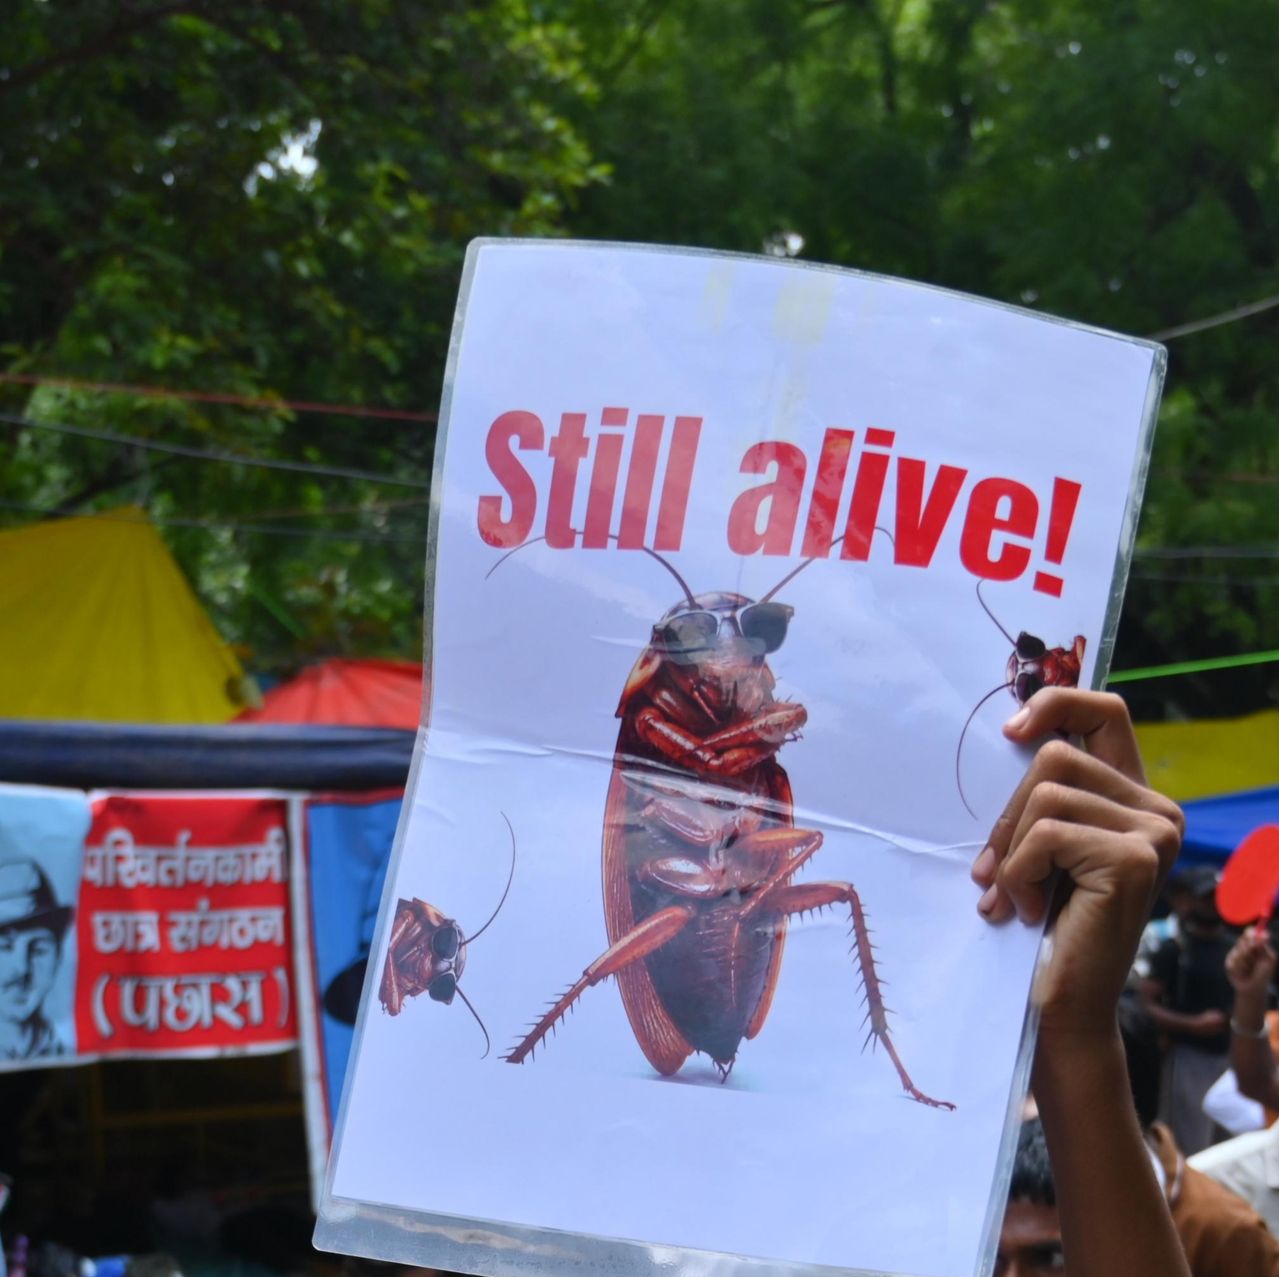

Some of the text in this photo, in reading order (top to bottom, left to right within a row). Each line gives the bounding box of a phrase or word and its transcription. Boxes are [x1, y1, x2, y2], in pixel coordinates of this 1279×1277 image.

[477, 406, 1082, 599] Still alive!
[93, 898, 286, 954] छात्र संगठन
